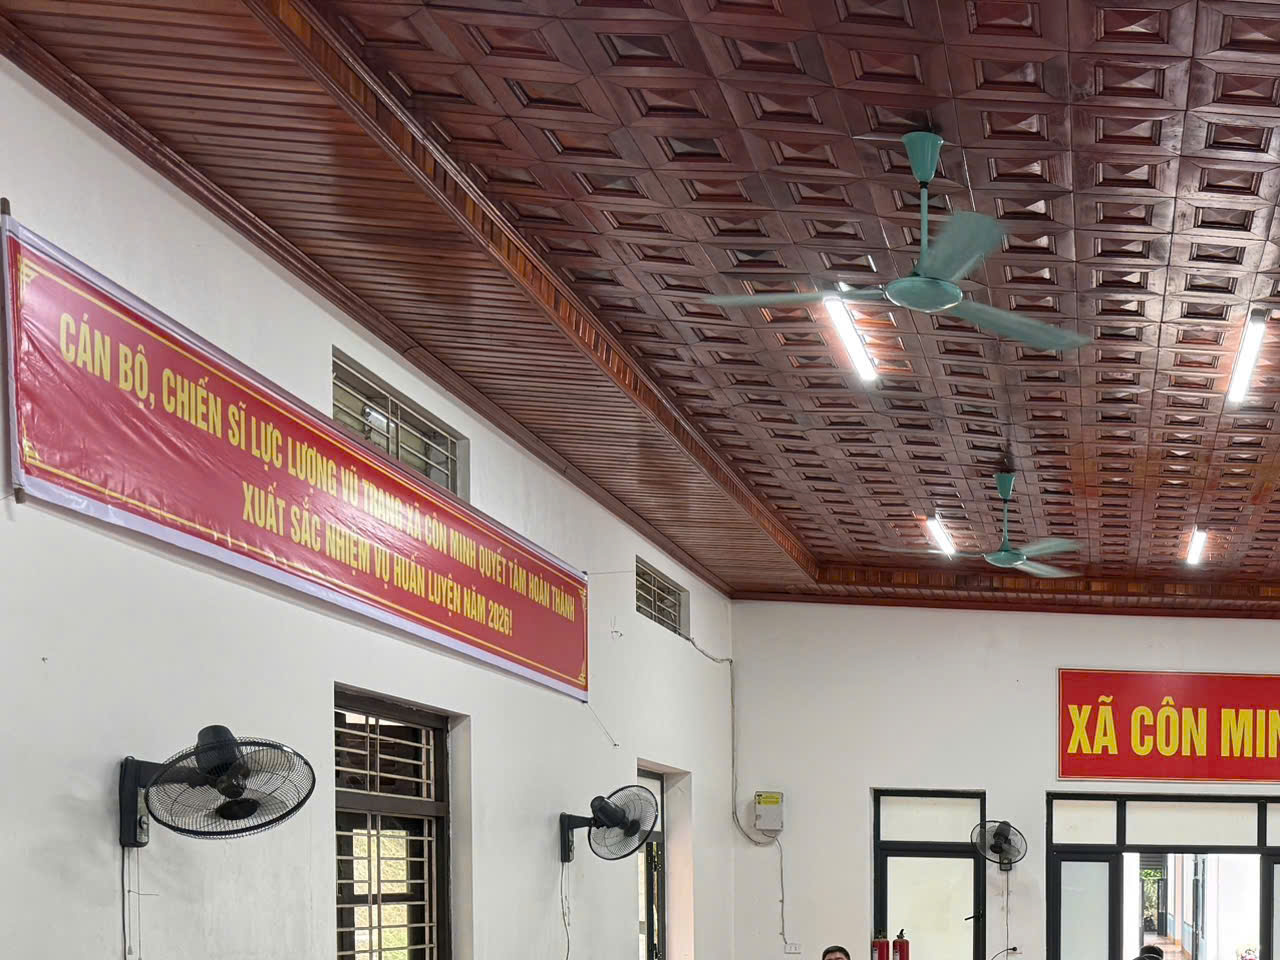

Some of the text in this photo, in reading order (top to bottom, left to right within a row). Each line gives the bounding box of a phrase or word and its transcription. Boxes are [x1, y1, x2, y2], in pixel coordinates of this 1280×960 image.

[59, 313, 576, 623] CÁN BỘ, CHIẾN SĨ LỰC LƯỢNG VŨ TRANG XÃ CÔN MINH QUYẾT TÂM HOÀN THÀNH
[243, 480, 513, 637] XUẤT SẮC NHIỆM VỤ HUẤN LUYỆN NĂM 2026!
[1066, 694, 1119, 755] XÃ
[1130, 696, 1208, 757] CÔN
